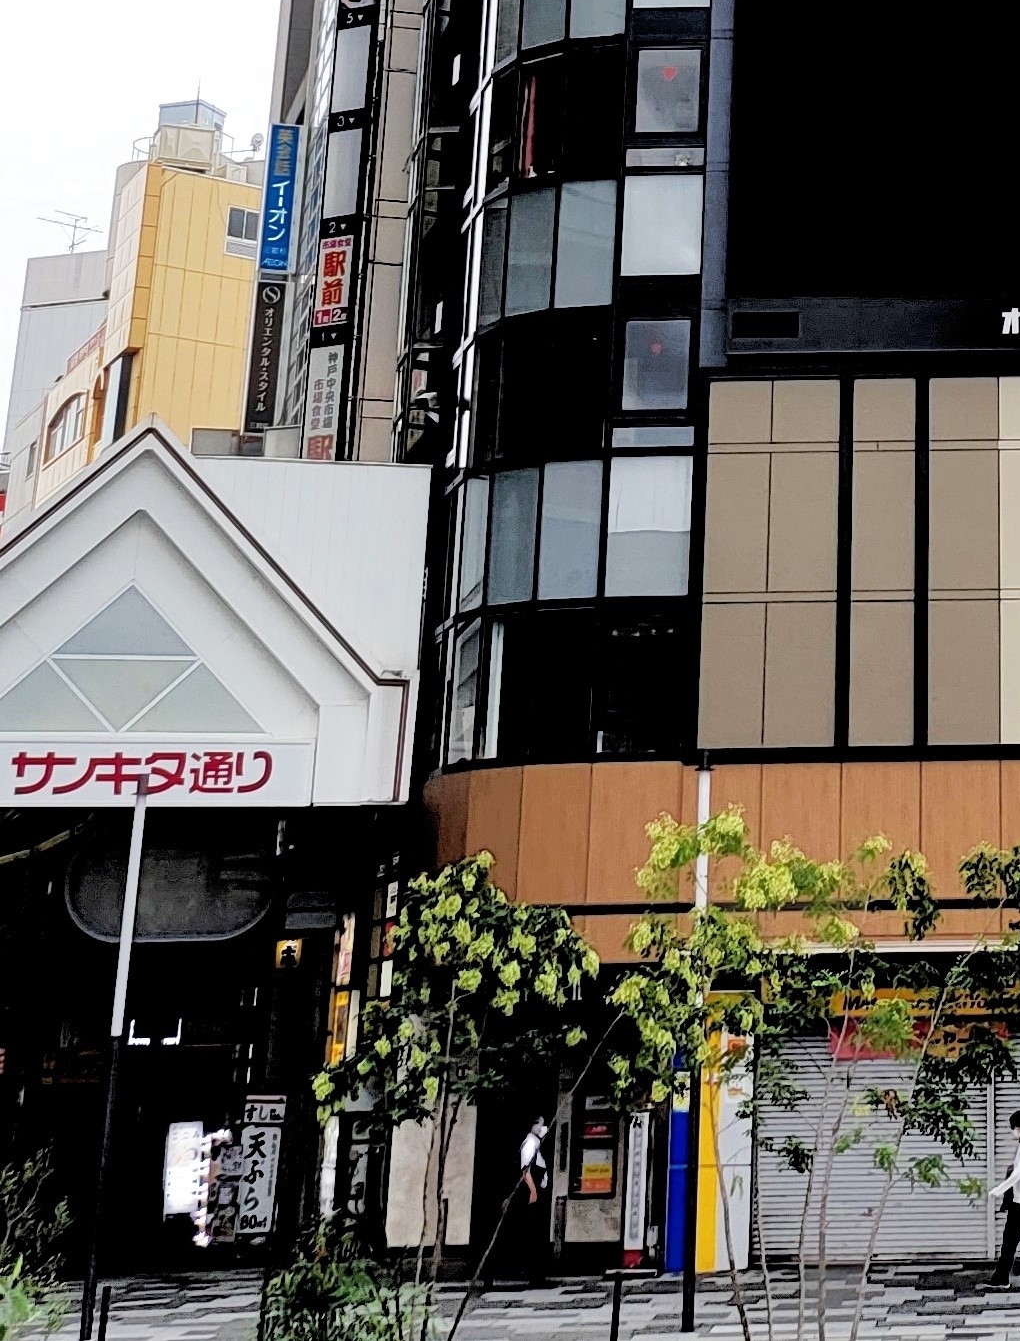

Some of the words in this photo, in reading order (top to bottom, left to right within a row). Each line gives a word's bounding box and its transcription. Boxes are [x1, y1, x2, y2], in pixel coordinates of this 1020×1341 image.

[346, 12, 354, 24] 5
[267, 180, 290, 241] イーオン
[328, 221, 336, 233] 2
[322, 250, 347, 307] 駅前
[255, 307, 275, 412] オリエンタル・スタイル
[322, 351, 339, 429] 神戸中央市場
